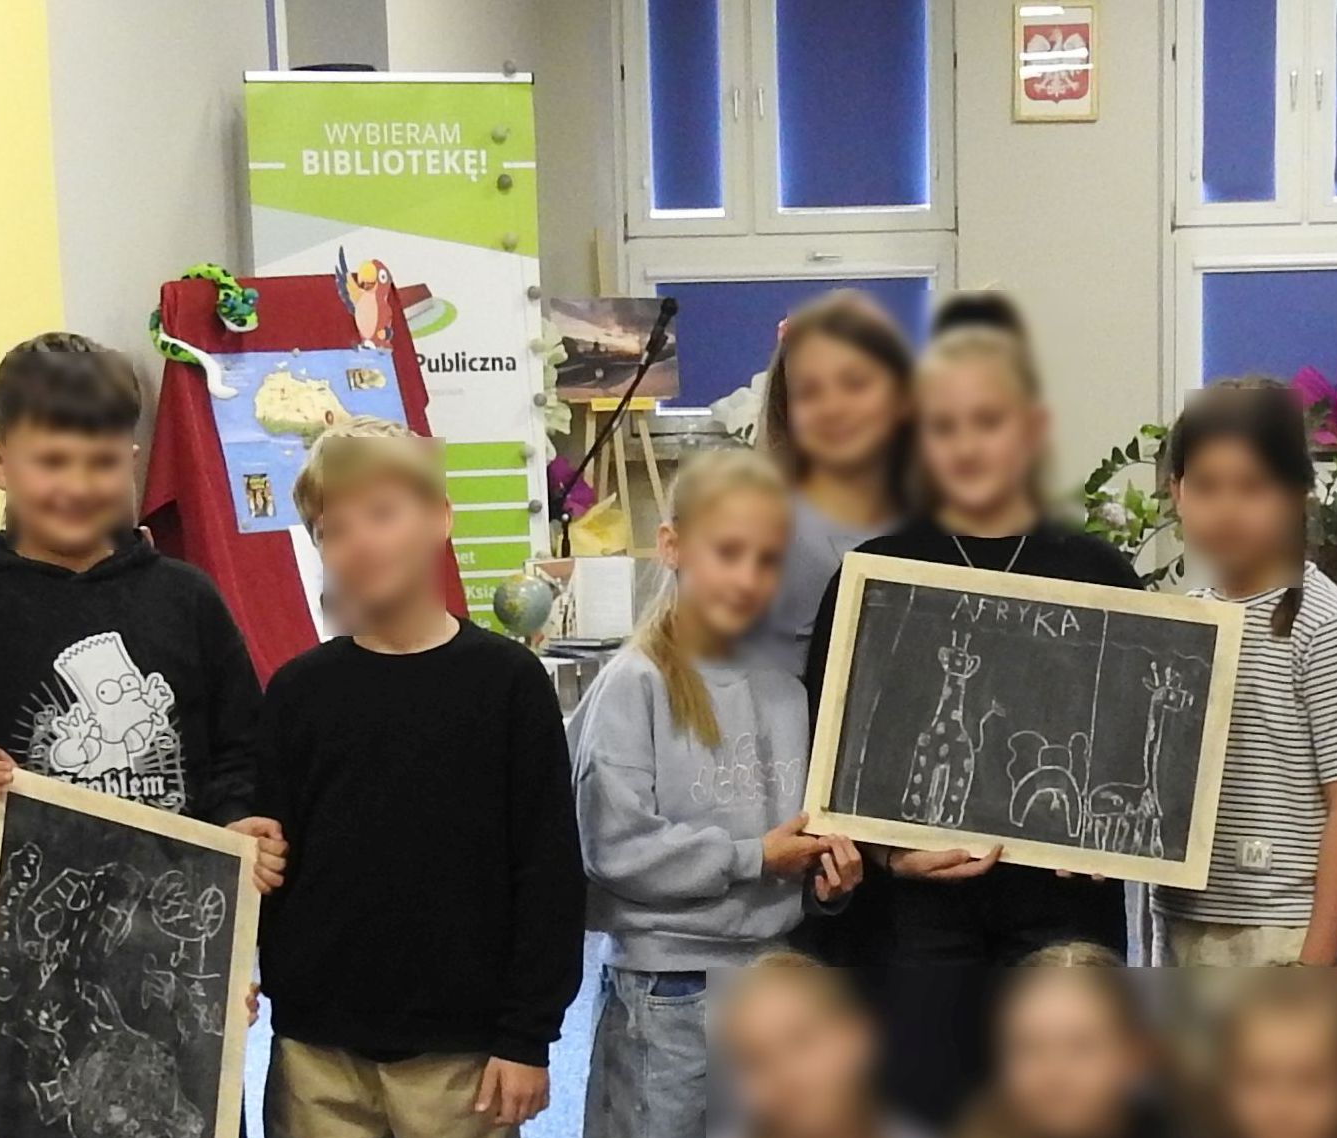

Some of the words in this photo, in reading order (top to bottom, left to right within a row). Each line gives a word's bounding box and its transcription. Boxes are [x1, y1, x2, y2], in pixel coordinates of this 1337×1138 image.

[324, 122, 461, 146] WYBIERAM
[302, 149, 488, 182] BIBLIOTEKĘ!
[950, 593, 1081, 637] AFRYKA
